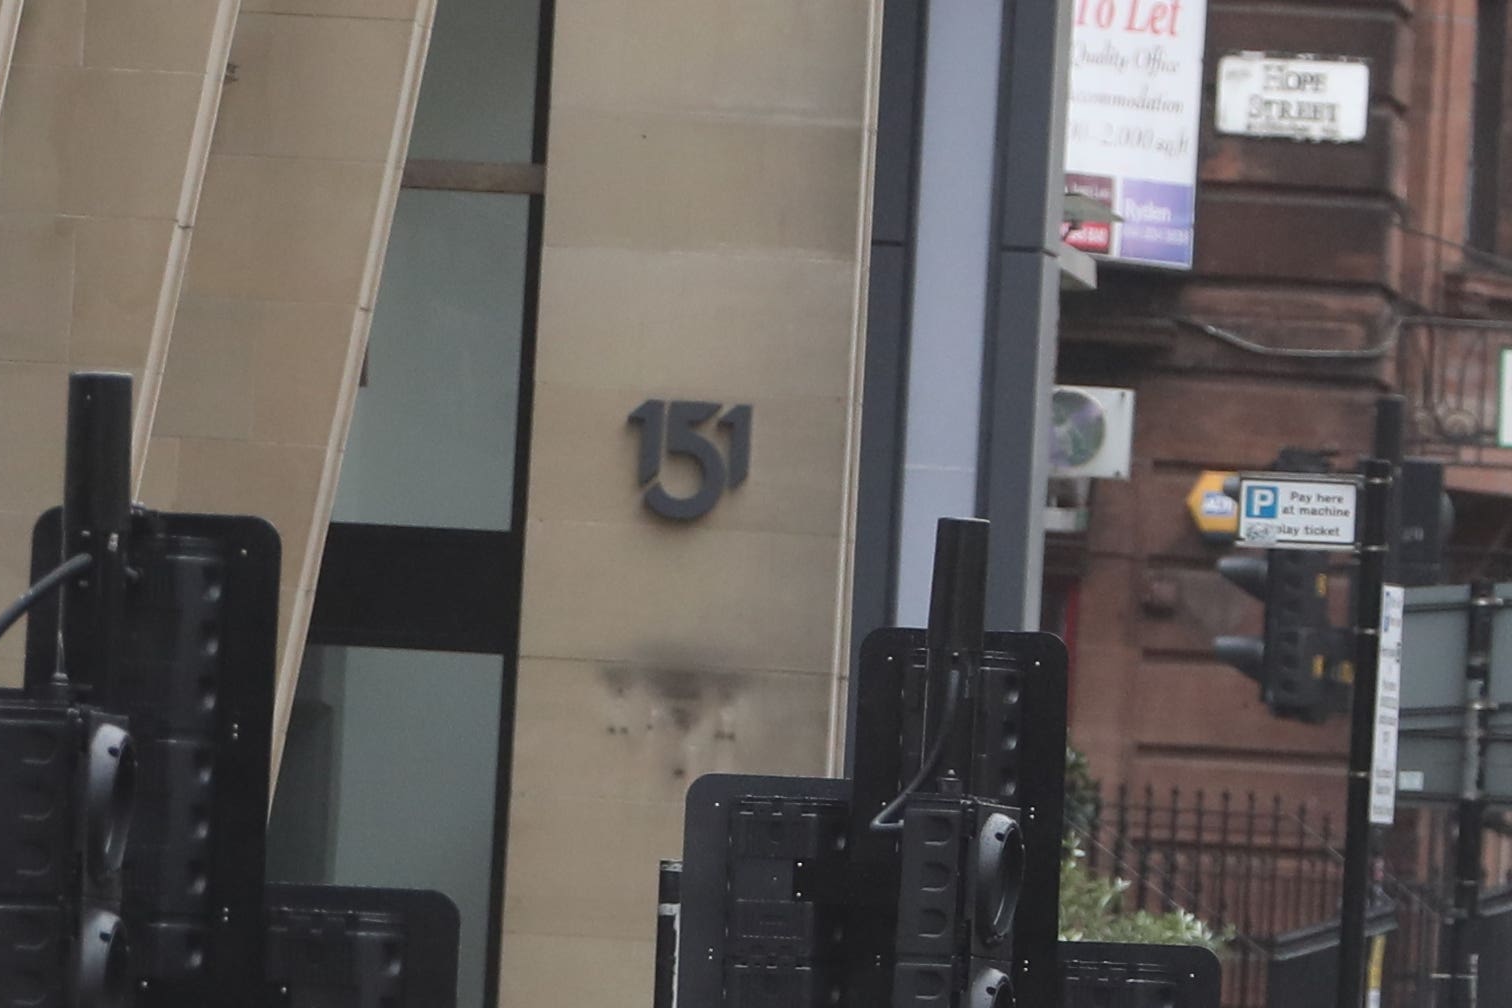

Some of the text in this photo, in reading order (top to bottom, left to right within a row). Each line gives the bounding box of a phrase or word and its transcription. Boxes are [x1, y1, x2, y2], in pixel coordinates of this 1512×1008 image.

[1074, 0, 1182, 37] To Let
[1262, 64, 1327, 92] HOPE
[1248, 94, 1342, 122] STREET
[627, 398, 754, 523] 151
[1290, 490, 1344, 504] Pay here
[1282, 505, 1351, 518] at machine
[1304, 524, 1341, 537] ticket
